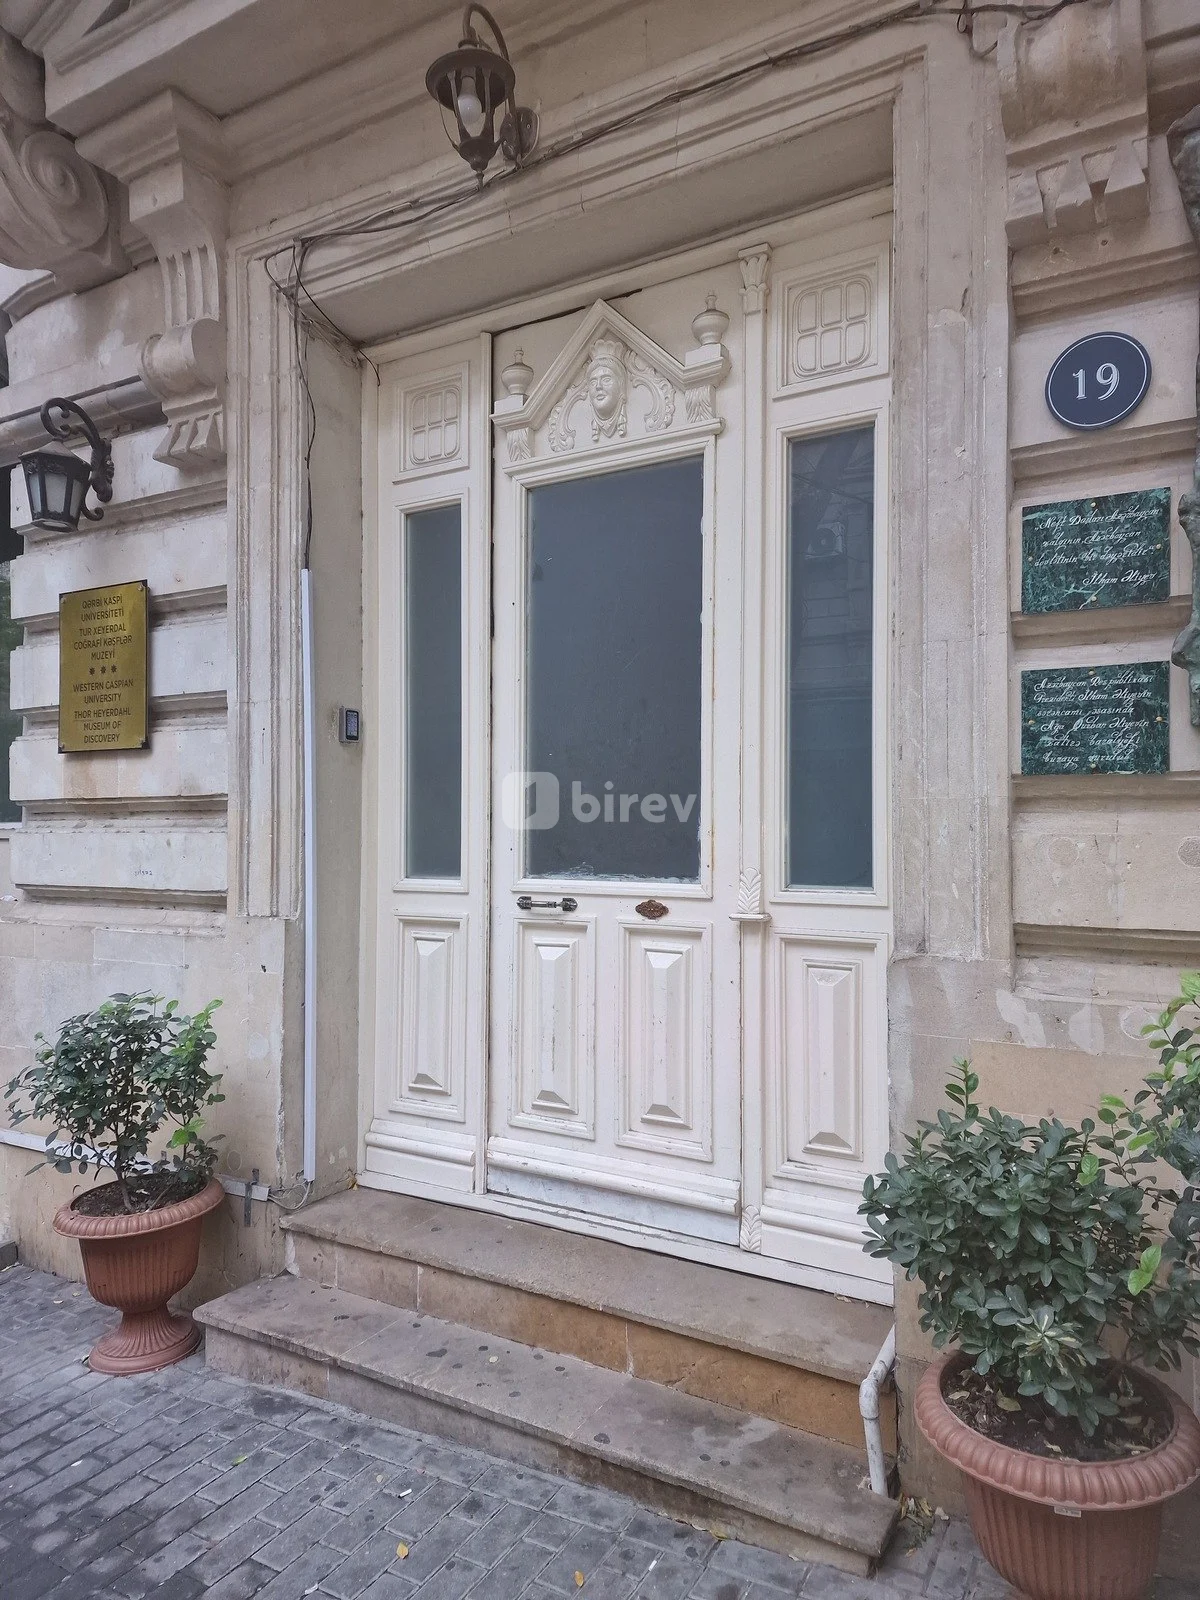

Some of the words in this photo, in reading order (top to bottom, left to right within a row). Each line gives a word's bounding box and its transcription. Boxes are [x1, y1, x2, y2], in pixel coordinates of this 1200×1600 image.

[1072, 362, 1120, 400] 19
[1120, 569, 1157, 588] Əliyev
[80, 628, 92, 637] TUR
[93, 623, 127, 635] XEYERDAL
[73, 682, 104, 692] WESTERN
[106, 678, 133, 689] CASPIAN
[84, 693, 121, 704] UNIVERSITY
[74, 709, 92, 719] THOR
[94, 707, 131, 717] HEYERDAHL
[84, 722, 111, 731] MUSEUM
[112, 721, 121, 730] OF
[84, 733, 120, 744] DISCOVERY
